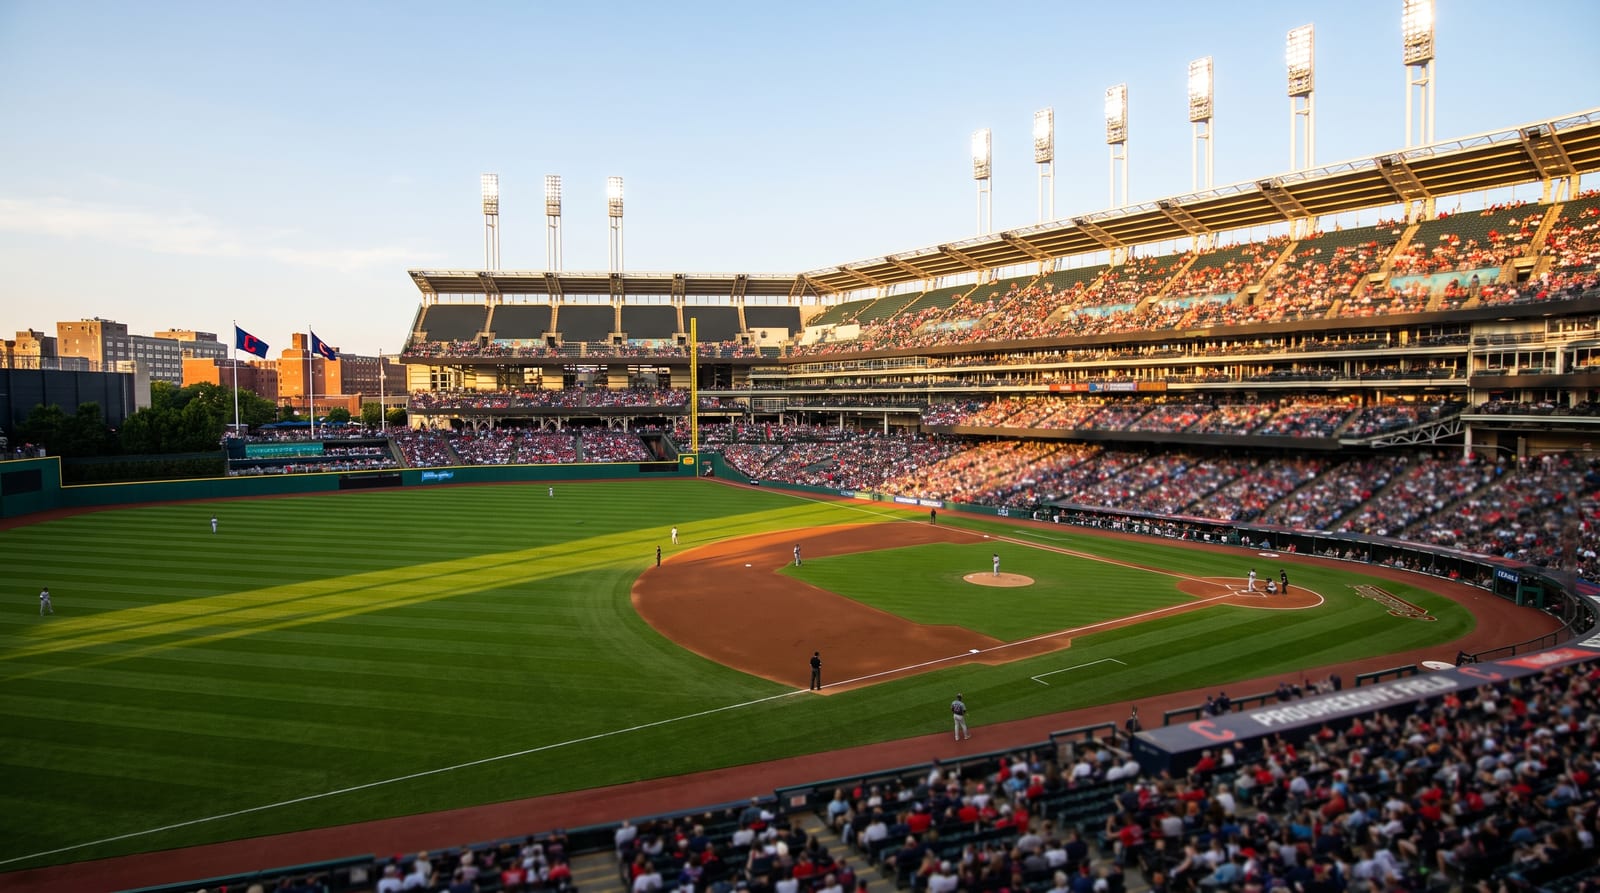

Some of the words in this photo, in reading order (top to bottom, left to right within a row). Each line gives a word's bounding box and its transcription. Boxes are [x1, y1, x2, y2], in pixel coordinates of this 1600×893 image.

[244, 334, 257, 353] C
[1250, 687, 1404, 727] PROGRESSIVE
[1392, 676, 1458, 696] FIELD
[1188, 719, 1236, 741] C
